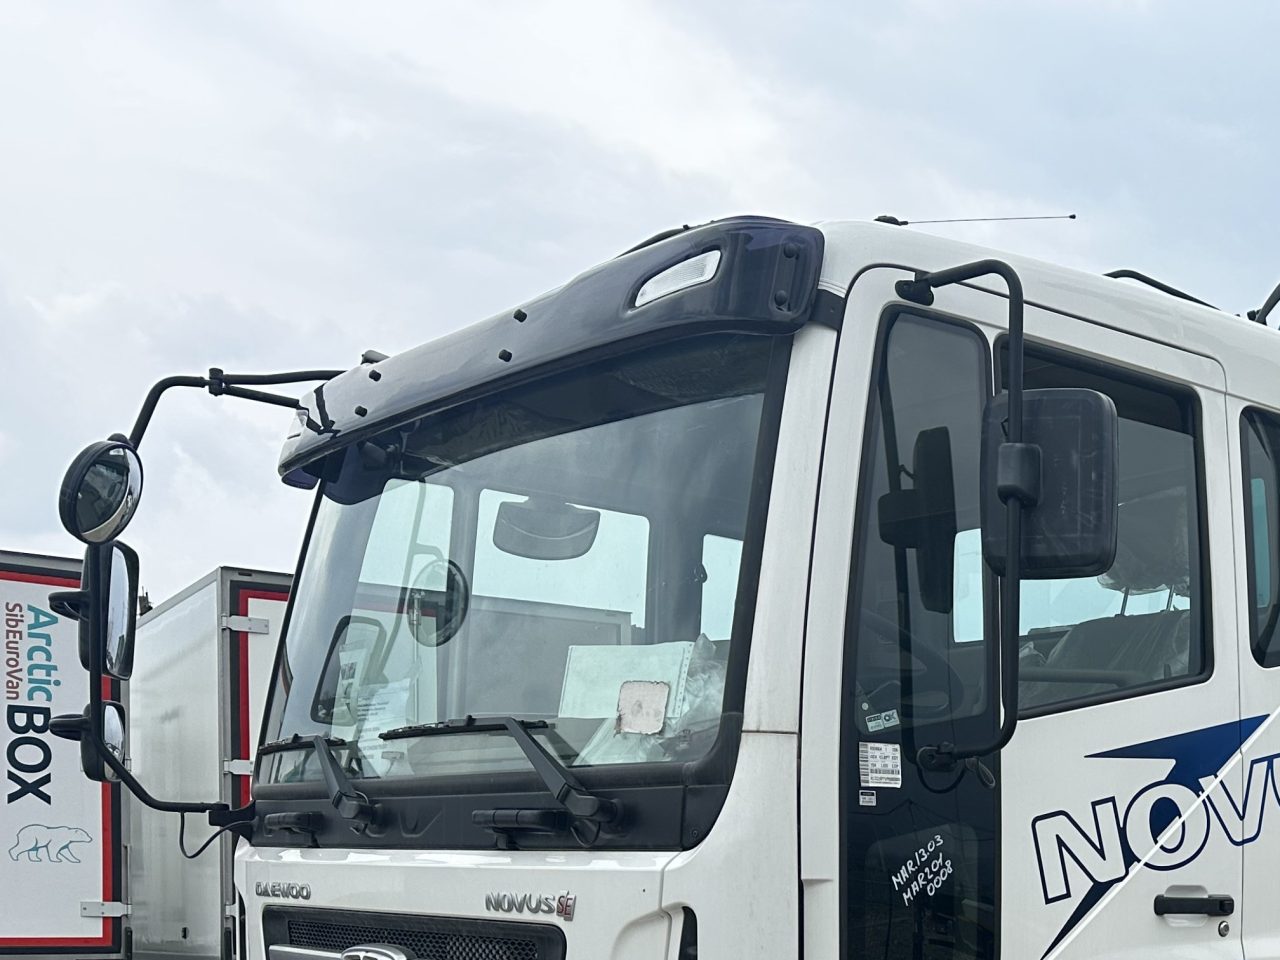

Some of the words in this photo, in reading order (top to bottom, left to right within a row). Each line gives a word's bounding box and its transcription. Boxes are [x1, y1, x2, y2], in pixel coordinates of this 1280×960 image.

[5, 602, 25, 700] SibEuroVan
[27, 604, 62, 702] Arctic
[7, 704, 52, 806] BOX
[255, 881, 311, 900] DAEWOO
[485, 891, 556, 914] NOVUS
[926, 859, 953, 896] 0008
